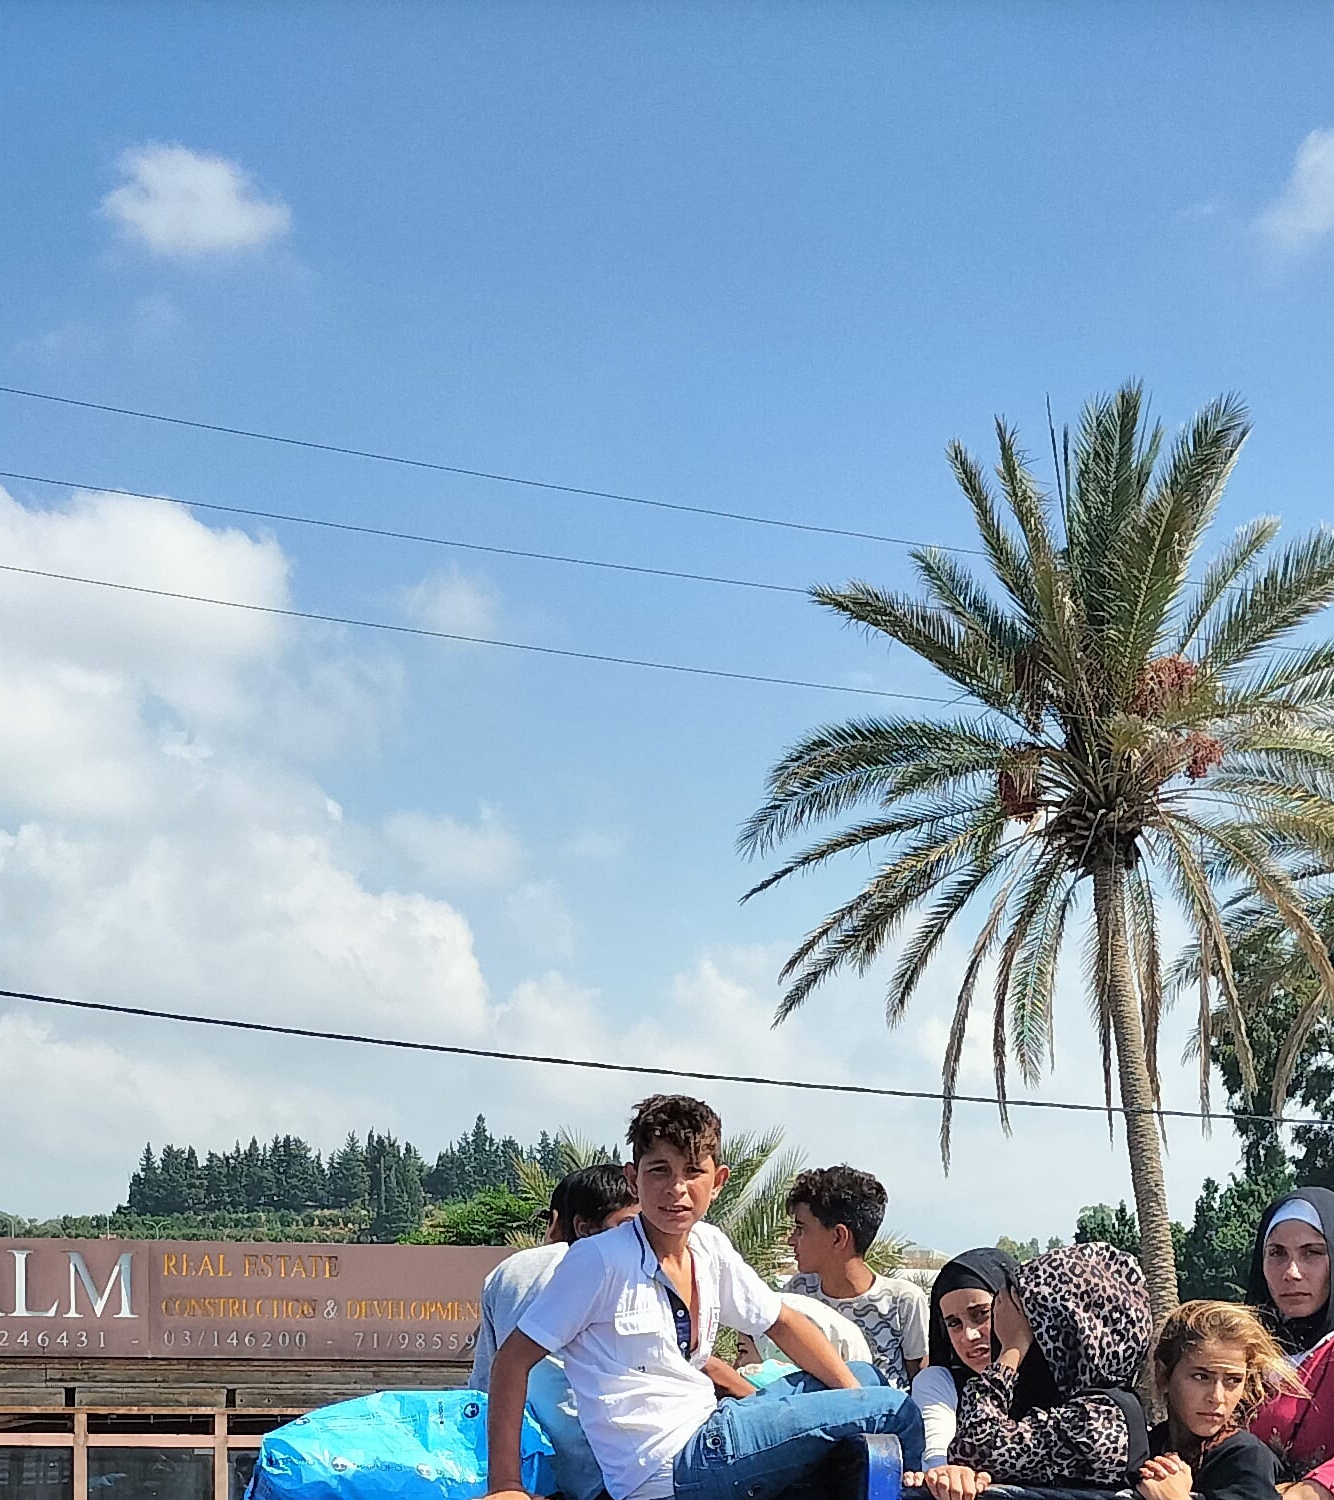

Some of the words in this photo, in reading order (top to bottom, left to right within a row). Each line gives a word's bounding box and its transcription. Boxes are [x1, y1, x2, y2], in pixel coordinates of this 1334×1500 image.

[163, 1253, 233, 1278] REAL
[243, 1254, 340, 1279] ESTATE
[161, 1297, 317, 1320] CONSTRUCTION
[323, 1299, 338, 1320] &
[346, 1300, 480, 1321] DEVELOPMEN
[163, 1330, 307, 1350] 03/146200
[354, 1331, 476, 1350] 71/98559
